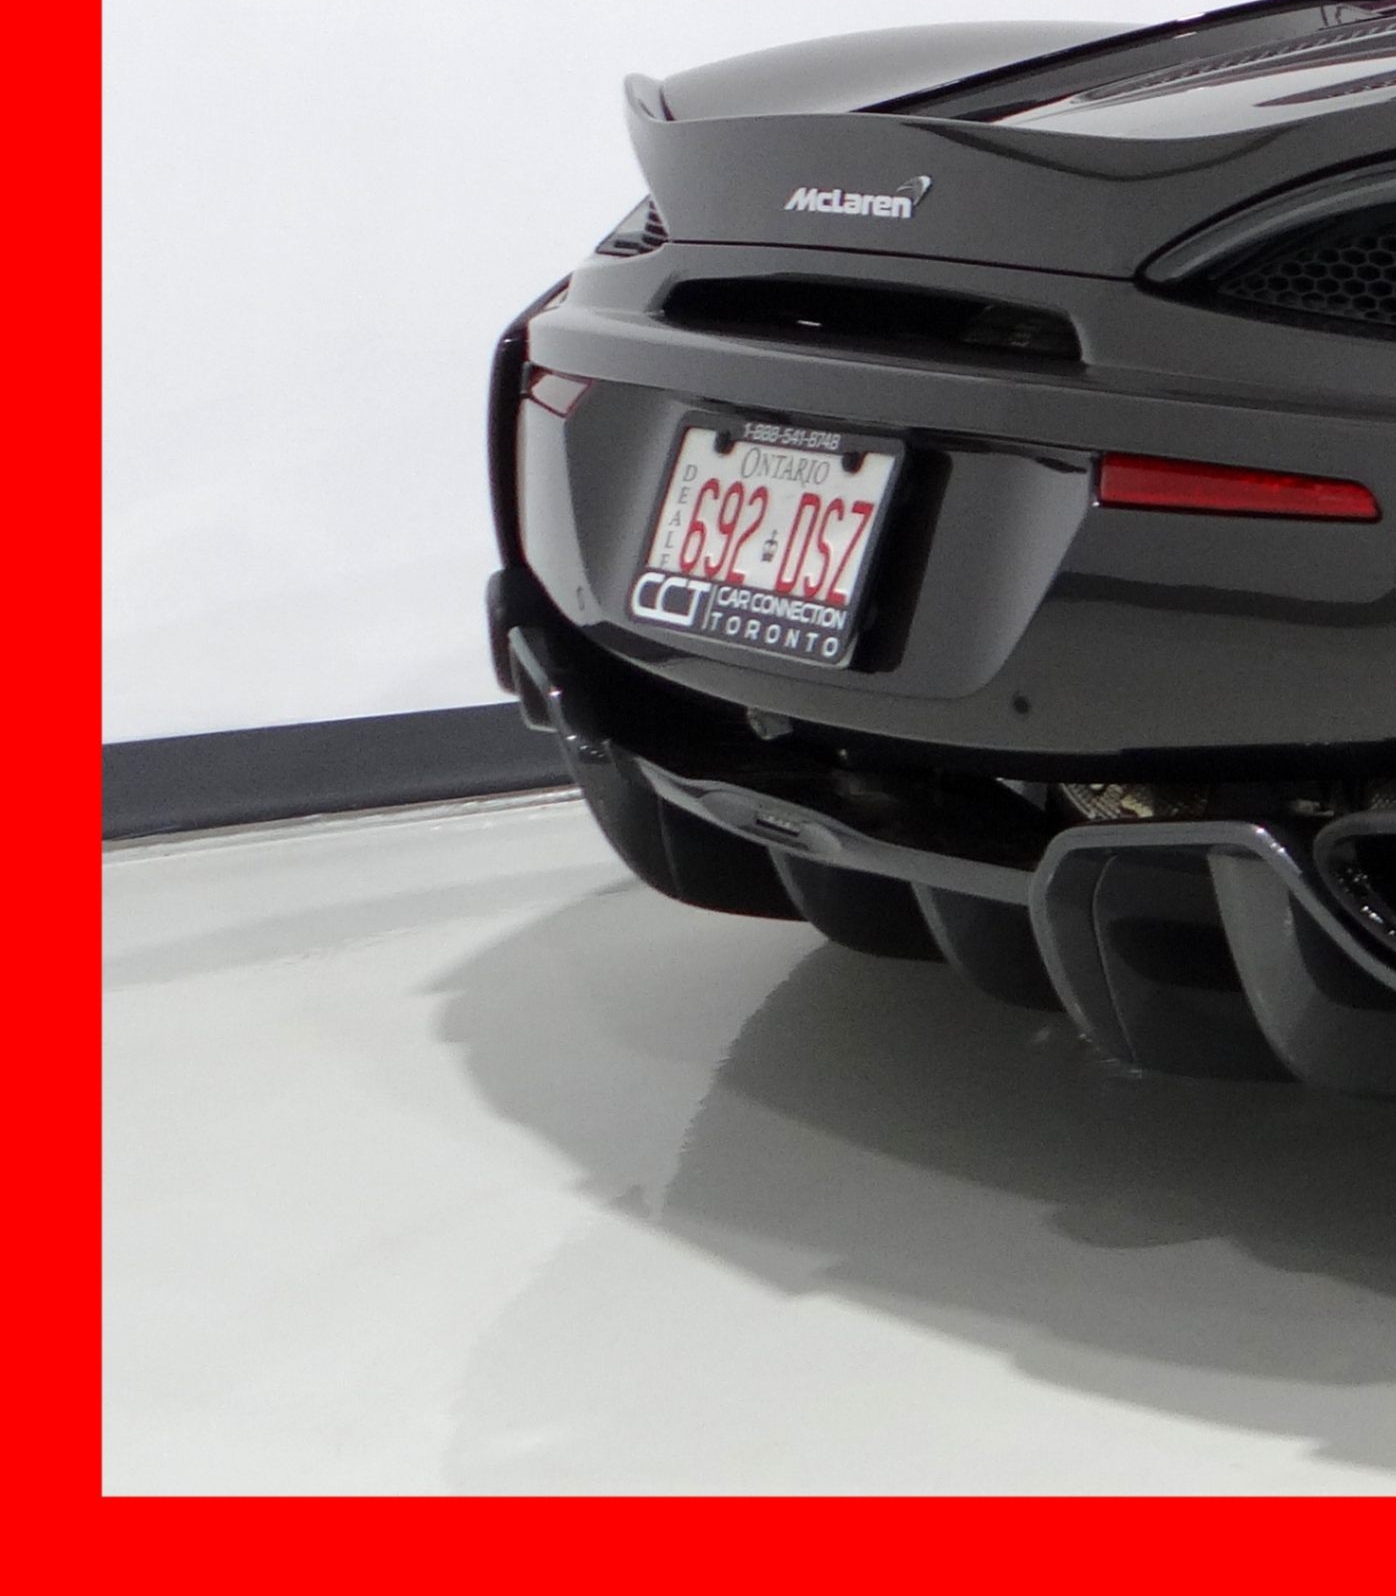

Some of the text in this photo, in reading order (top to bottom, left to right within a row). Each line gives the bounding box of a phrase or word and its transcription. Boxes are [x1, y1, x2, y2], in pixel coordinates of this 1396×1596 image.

[784, 186, 913, 219] McLaren
[743, 422, 841, 451] 1-888-541-8748
[740, 447, 831, 485] ONTARIO
[679, 477, 875, 606] 692 DSZ
[631, 572, 712, 626] CCT
[717, 586, 848, 630] CAR CONNECTION
[710, 612, 840, 658] TORONTO
